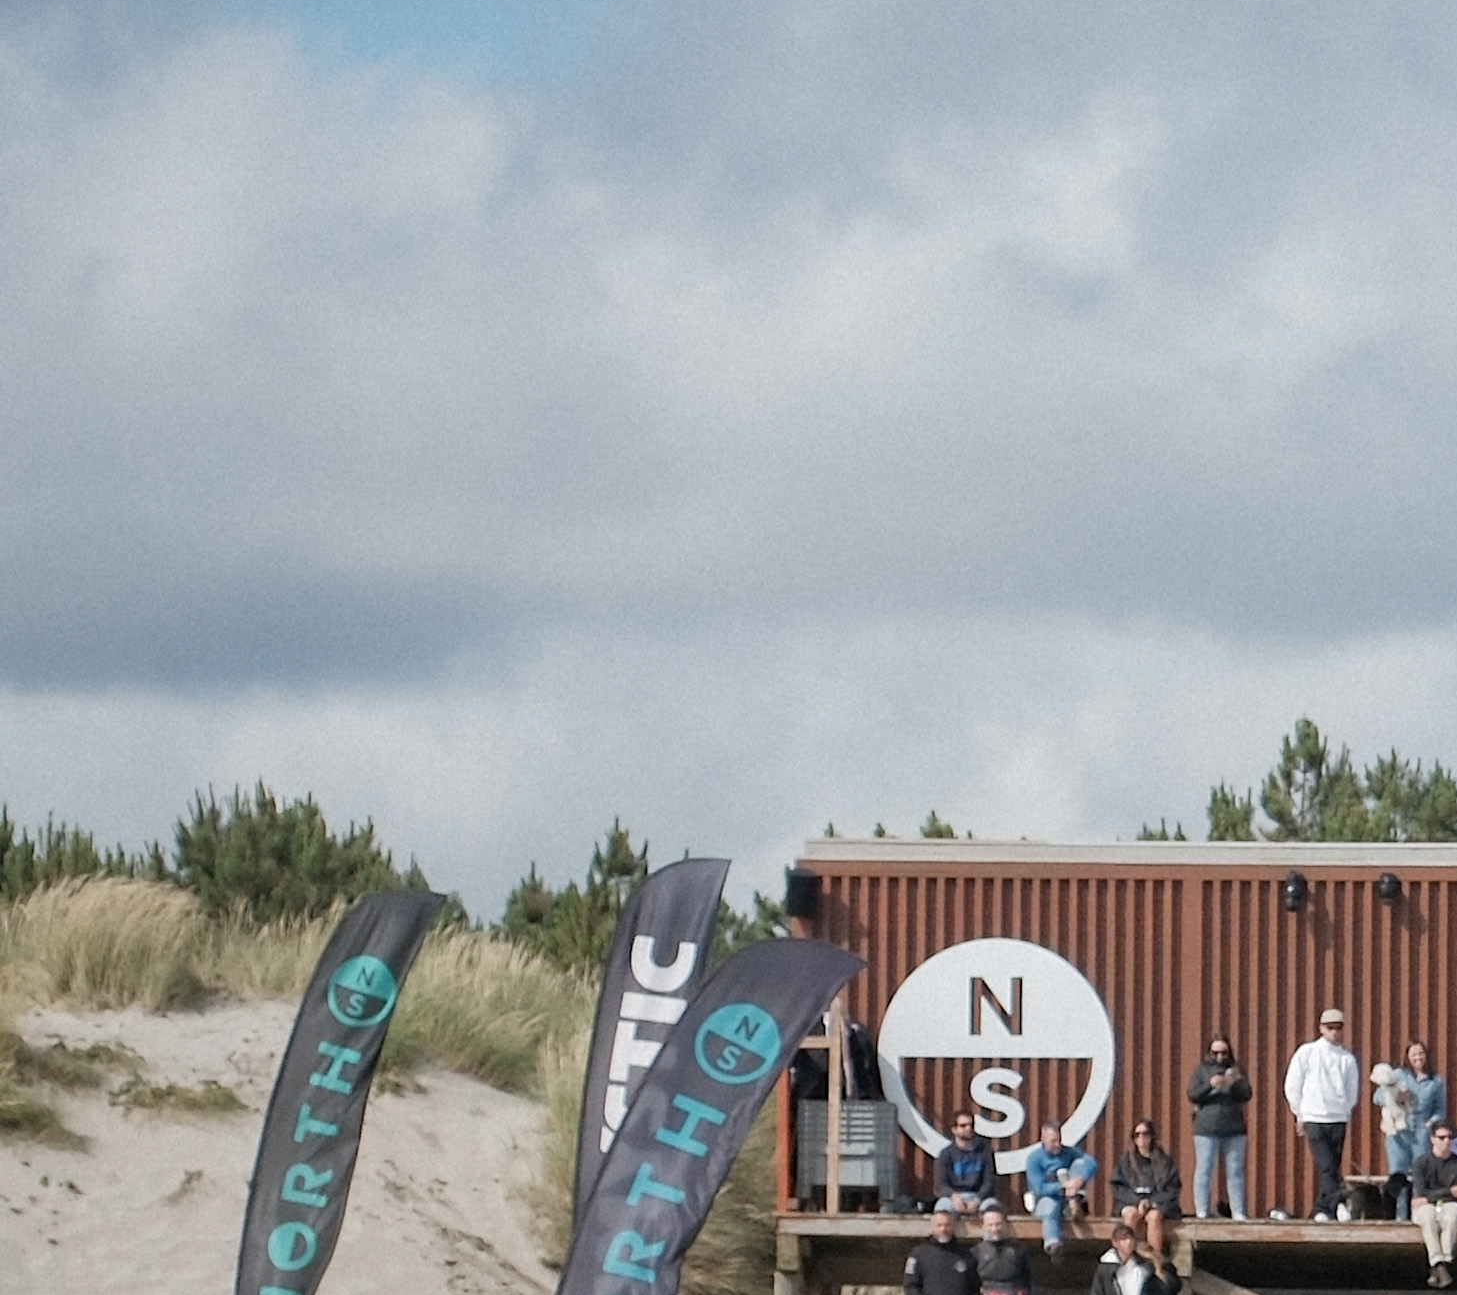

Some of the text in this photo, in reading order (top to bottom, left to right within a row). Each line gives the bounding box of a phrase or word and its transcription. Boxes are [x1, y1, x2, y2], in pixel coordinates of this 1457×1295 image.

[357, 967, 376, 986] N
[346, 993, 365, 1016] S
[968, 977, 1023, 1036] N
[734, 1016, 761, 1040] N
[716, 1045, 742, 1071] S
[969, 1066, 1026, 1139] S
